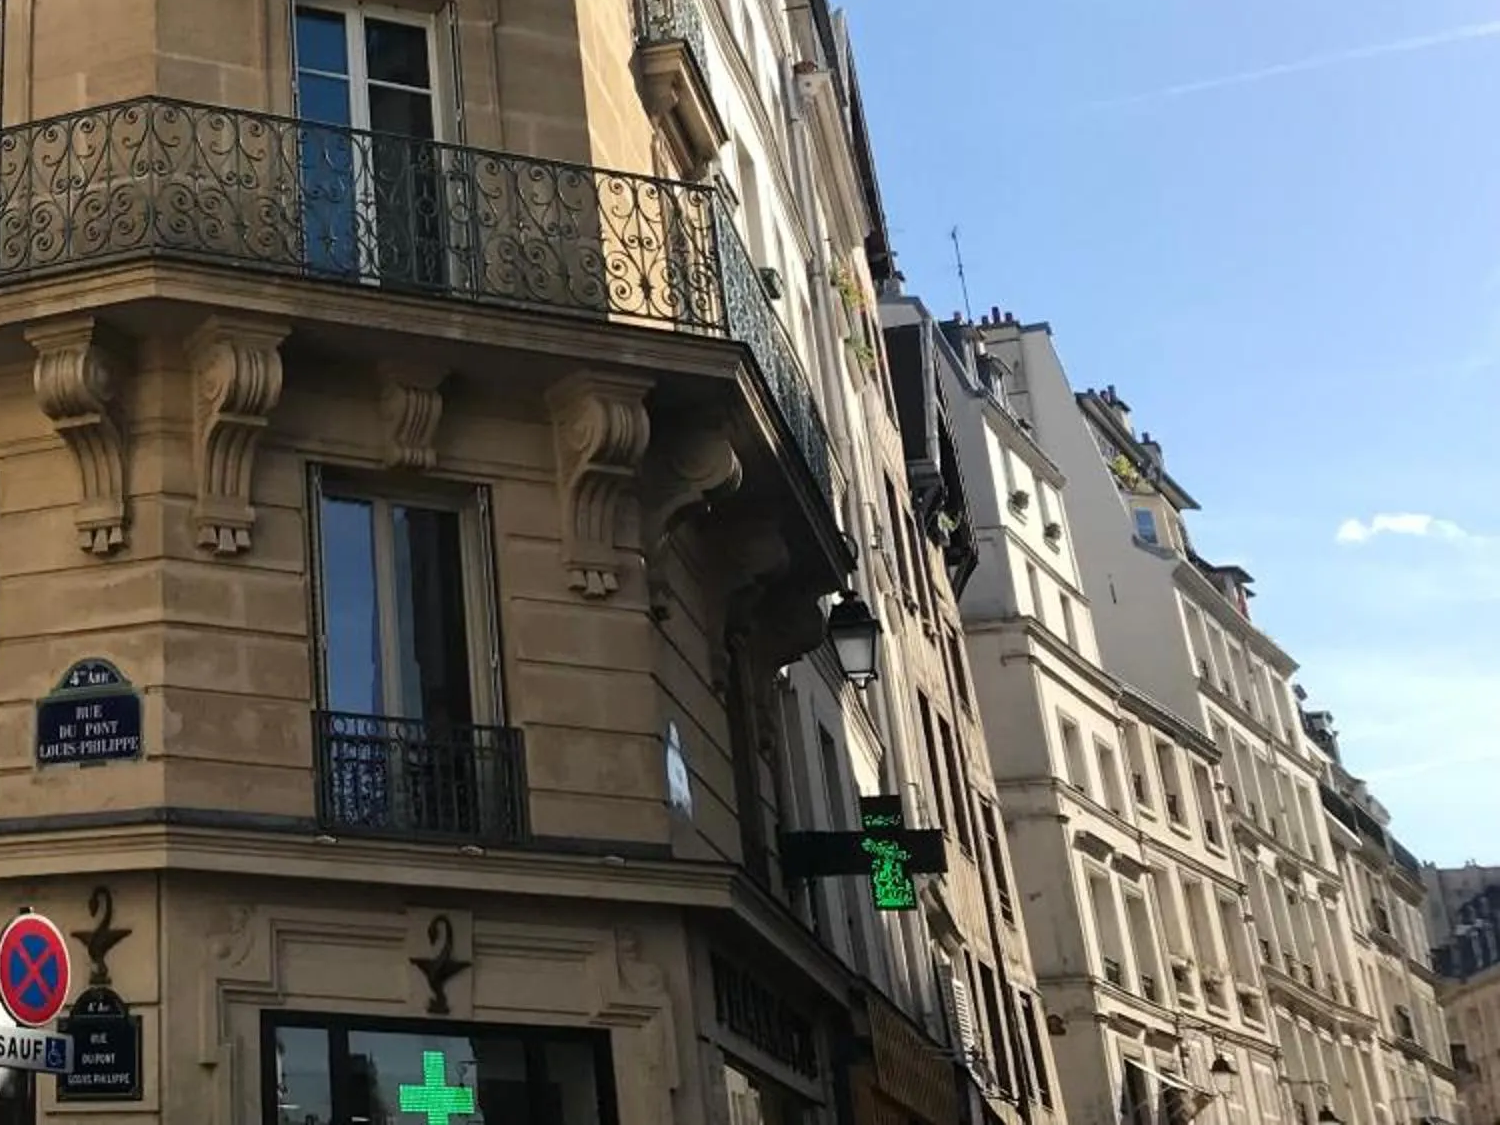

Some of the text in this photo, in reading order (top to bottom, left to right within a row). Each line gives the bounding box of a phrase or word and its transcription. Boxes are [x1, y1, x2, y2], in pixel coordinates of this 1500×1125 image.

[76, 705, 102, 720] RUE
[59, 721, 118, 740] DU PONT
